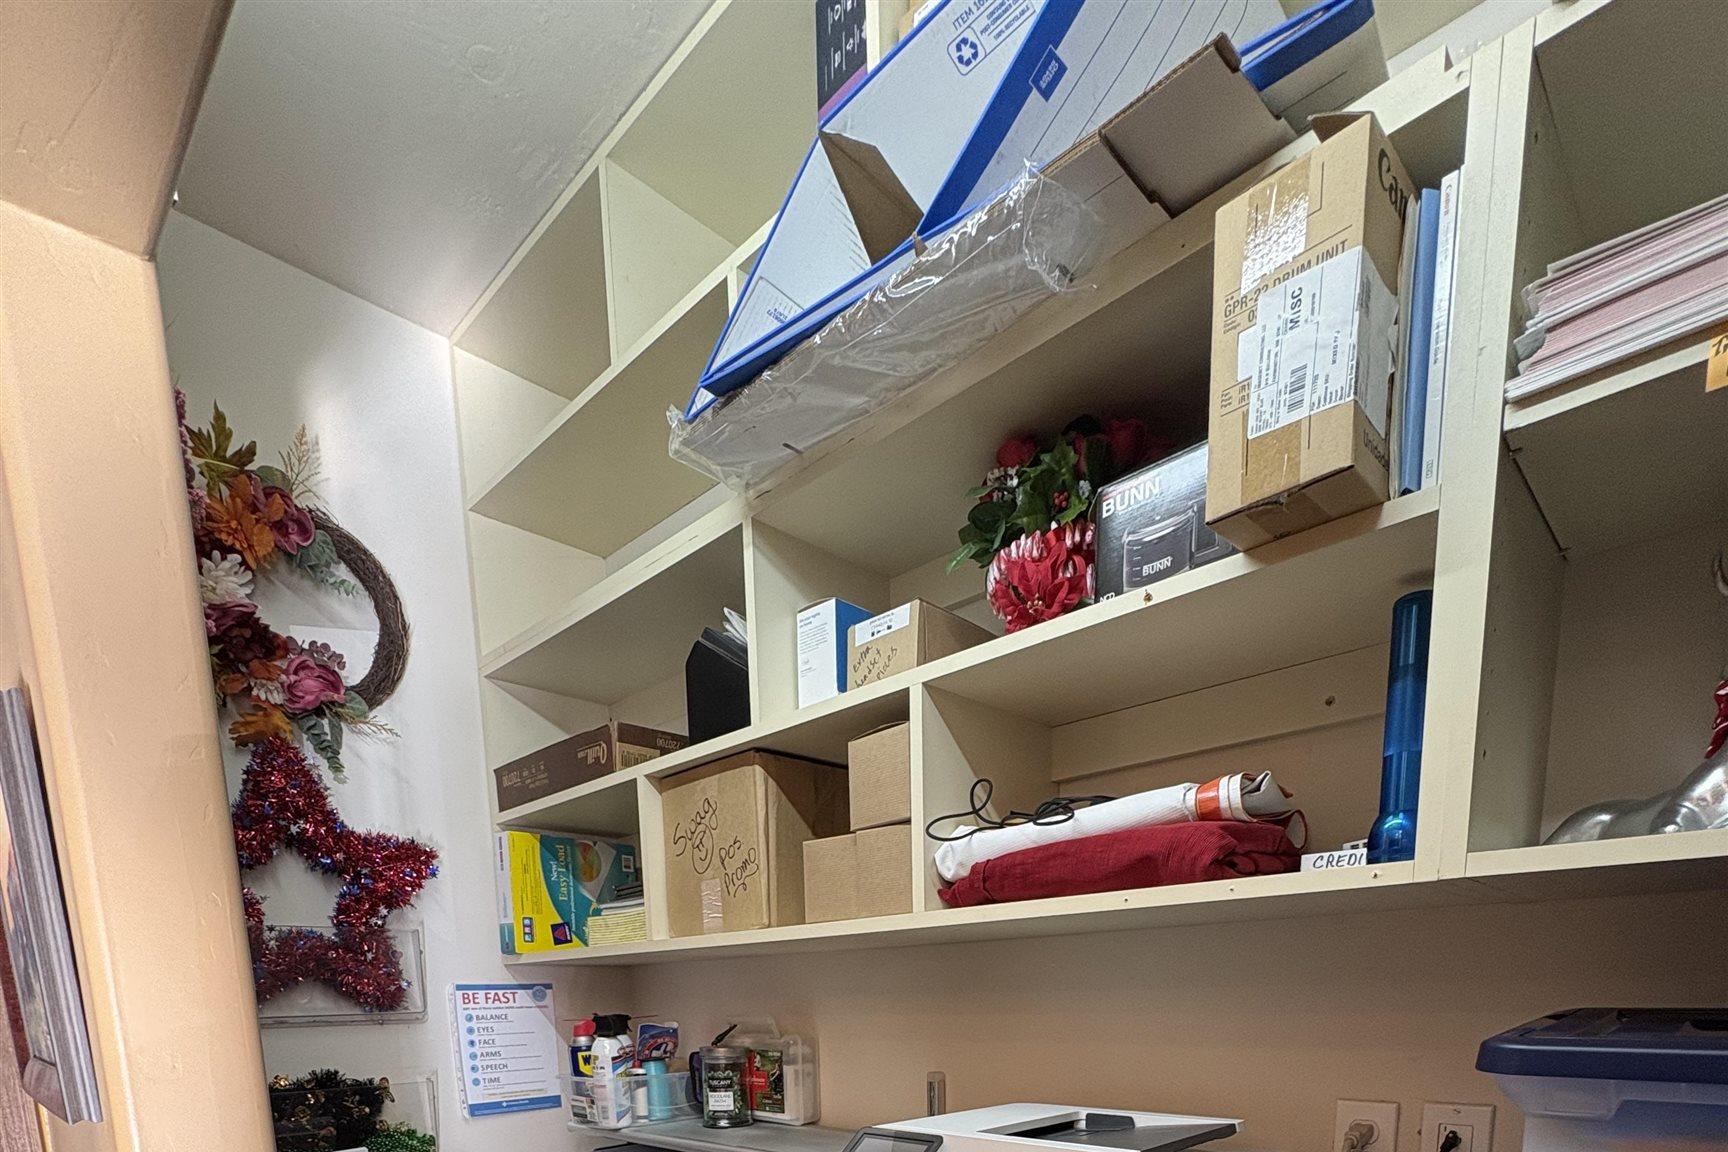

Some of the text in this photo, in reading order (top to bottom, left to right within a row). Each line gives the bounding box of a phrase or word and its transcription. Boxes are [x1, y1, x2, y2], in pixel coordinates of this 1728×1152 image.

[952, 8, 977, 31] ITEM
[1316, 239, 1349, 266] UNIT
[1288, 286, 1304, 332] MISC
[1102, 476, 1161, 518] BUNN
[1142, 555, 1173, 577] BUNN
[673, 798, 718, 857] Swag
[556, 844, 566, 873] Load
[1313, 853, 1364, 869] CREDI
[550, 861, 559, 881] New!
[559, 874, 570, 901] Easy
[461, 991, 519, 1005] BE FAST
[475, 1013, 509, 1021] BALANCE
[476, 1026, 495, 1034] EYES
[478, 1038, 496, 1046] FACE
[479, 1050, 502, 1059] ARMS
[480, 1063, 509, 1072] SPEECH
[481, 1077, 502, 1085] TIME
